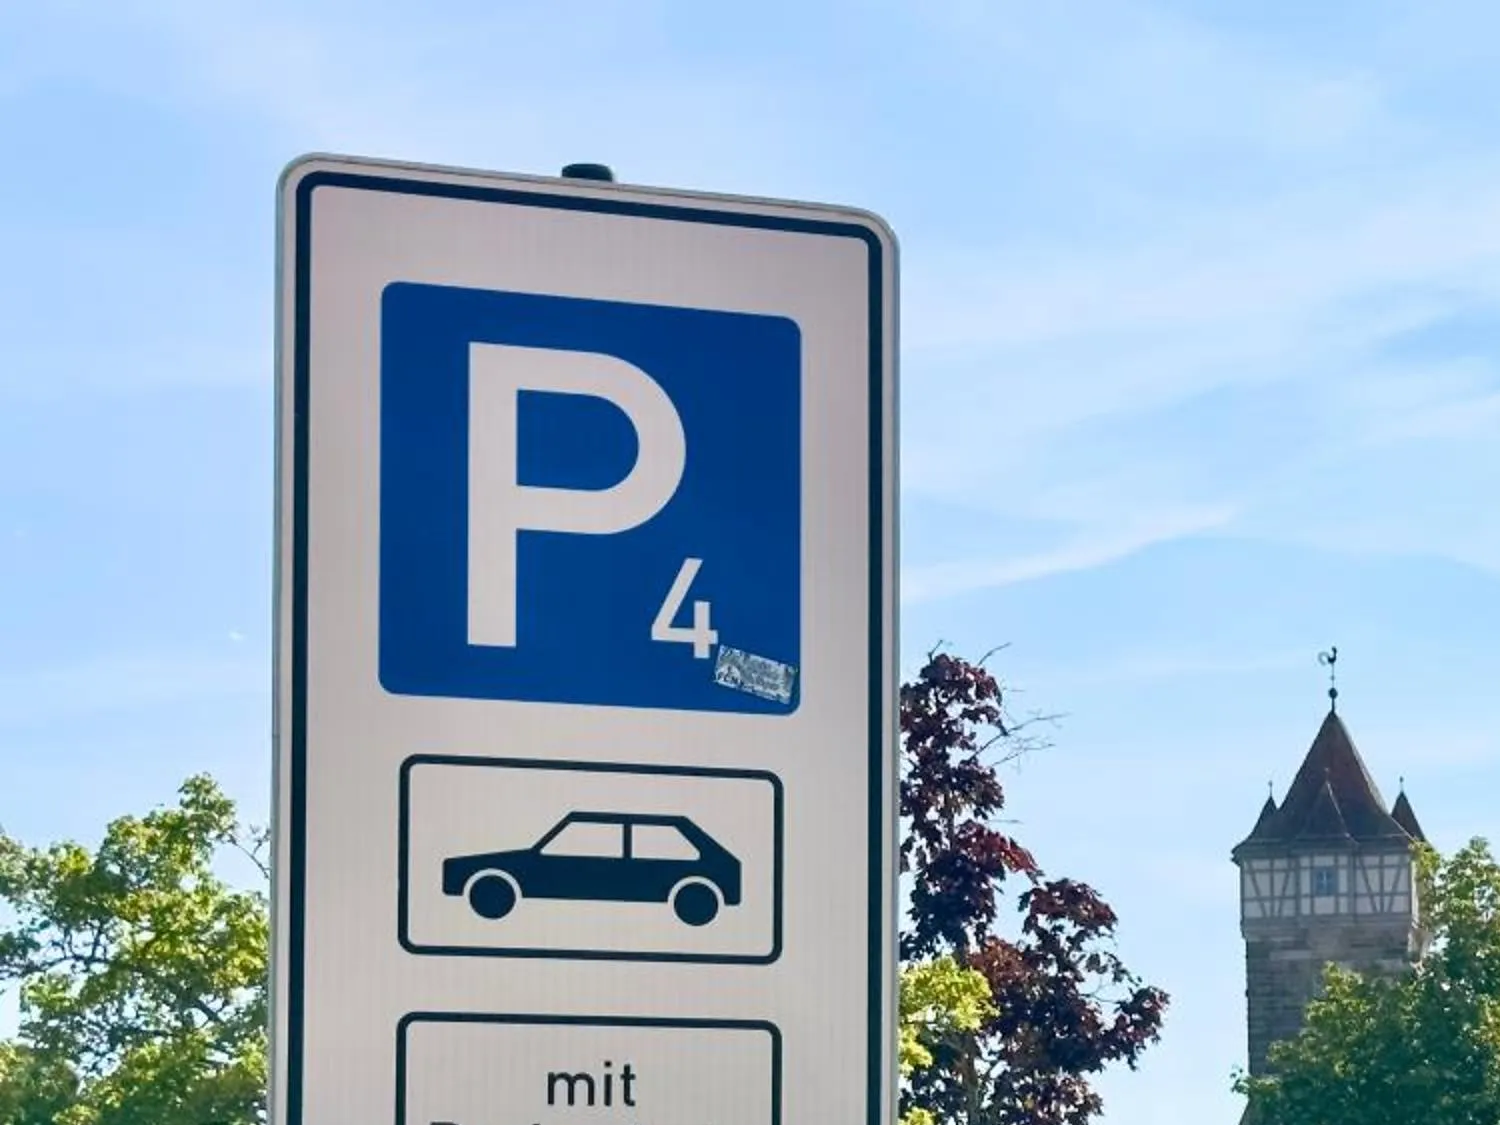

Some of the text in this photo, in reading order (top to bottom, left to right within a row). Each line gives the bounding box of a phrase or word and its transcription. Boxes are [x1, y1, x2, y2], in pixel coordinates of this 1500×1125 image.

[467, 342, 687, 648] P
[651, 557, 718, 659] 4
[547, 1060, 636, 1107] mit
